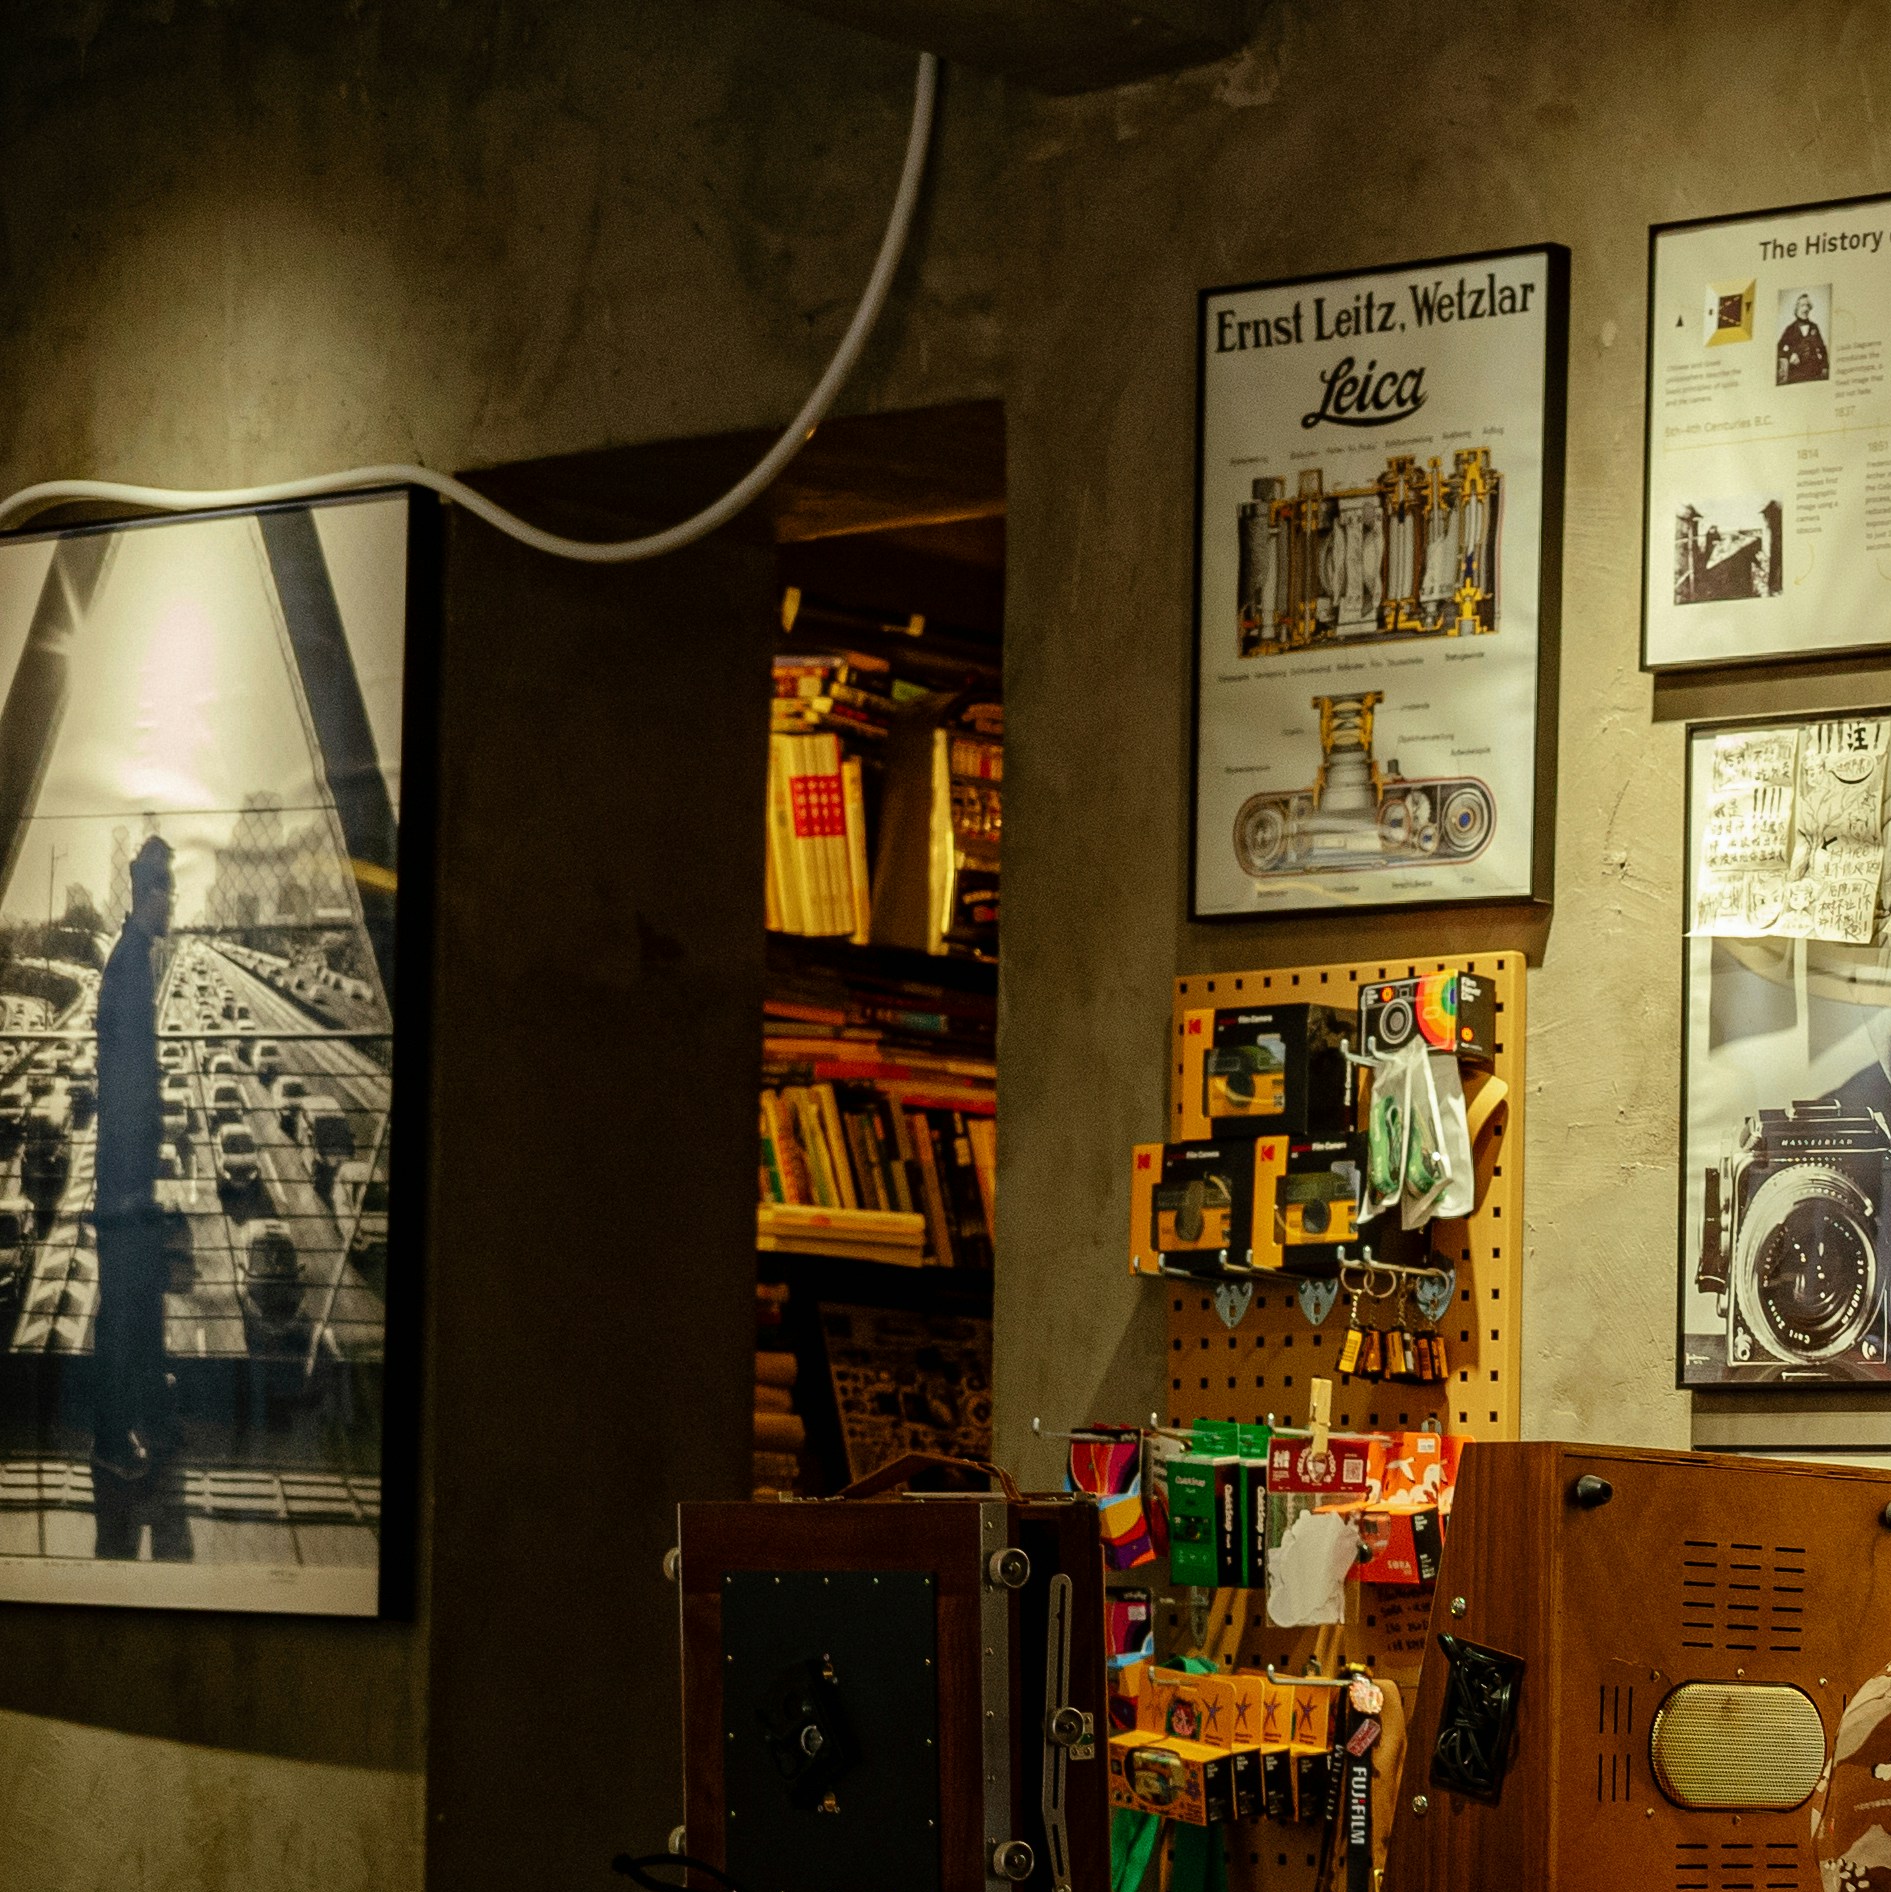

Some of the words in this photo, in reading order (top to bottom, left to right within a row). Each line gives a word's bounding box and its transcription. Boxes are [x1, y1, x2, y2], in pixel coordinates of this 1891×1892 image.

[1759, 237, 1798, 262] The
[1804, 226, 1884, 257] History
[1214, 304, 1302, 354] Ernst
[1312, 296, 1407, 345] Leitz,
[1409, 276, 1536, 330] Wetzlar
[1300, 355, 1430, 429] Leica
[1350, 1765, 1368, 1846] FUJIFILM
